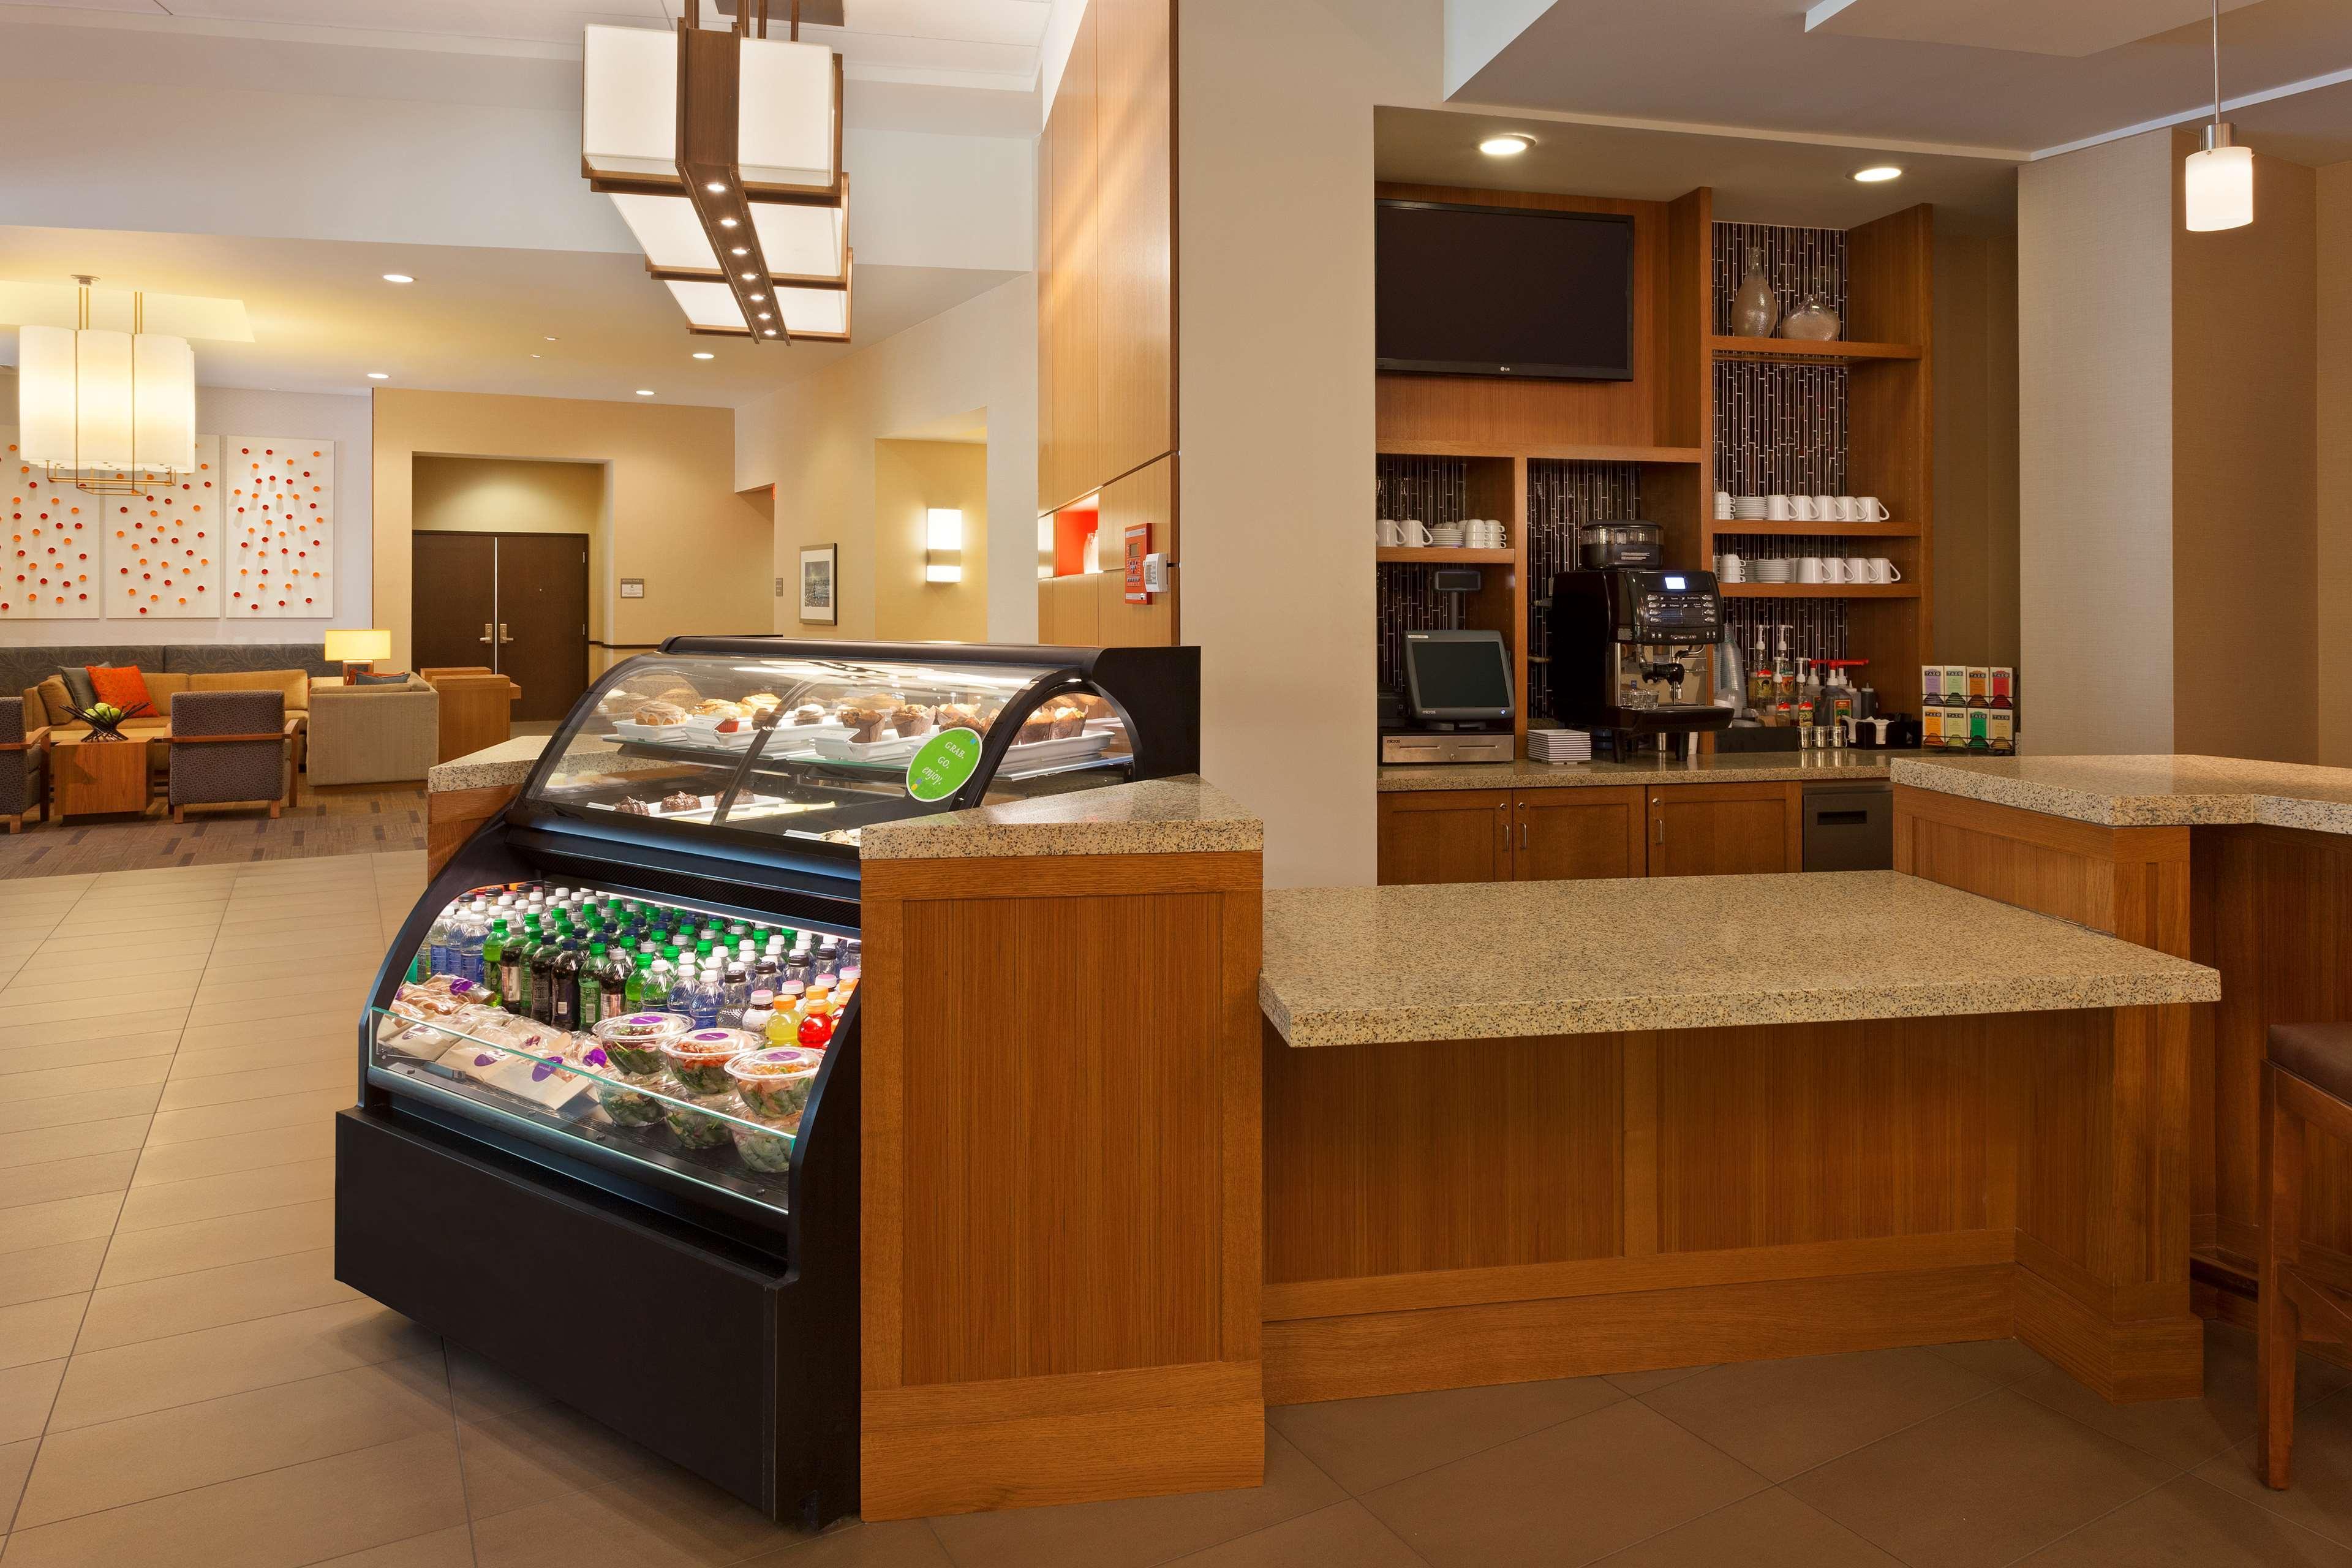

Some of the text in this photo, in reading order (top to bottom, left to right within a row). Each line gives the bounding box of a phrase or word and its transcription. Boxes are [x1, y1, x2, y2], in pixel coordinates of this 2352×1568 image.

[944, 741, 965, 759] GRAB.
[937, 756, 949, 769] GO.
[921, 767, 943, 785] enjoy.
